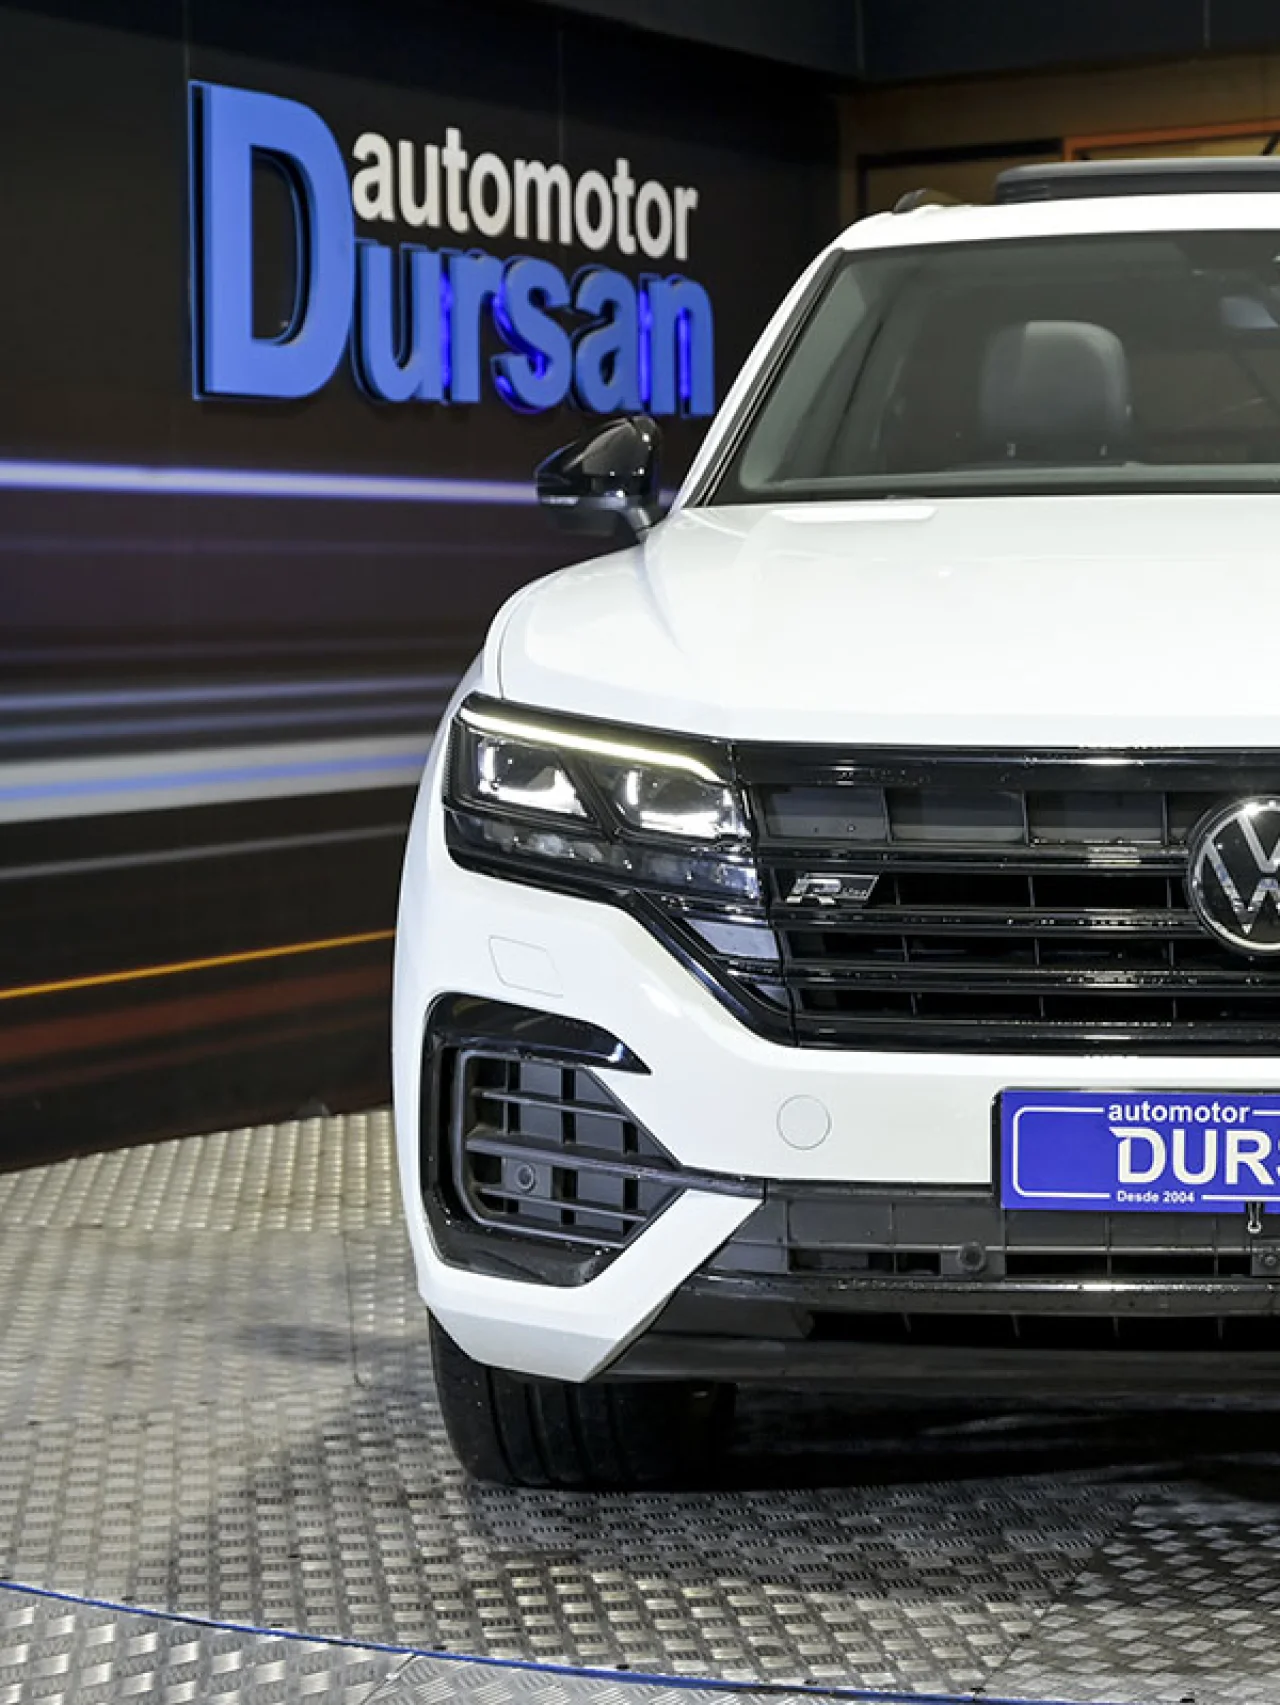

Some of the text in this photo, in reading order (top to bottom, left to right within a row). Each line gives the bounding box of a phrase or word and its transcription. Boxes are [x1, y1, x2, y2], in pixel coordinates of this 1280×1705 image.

[351, 127, 698, 260] automotor
[189, 79, 715, 418] Dursan
[1108, 1101, 1250, 1123] automotor
[1117, 1191, 1195, 1203] Desde 2004
